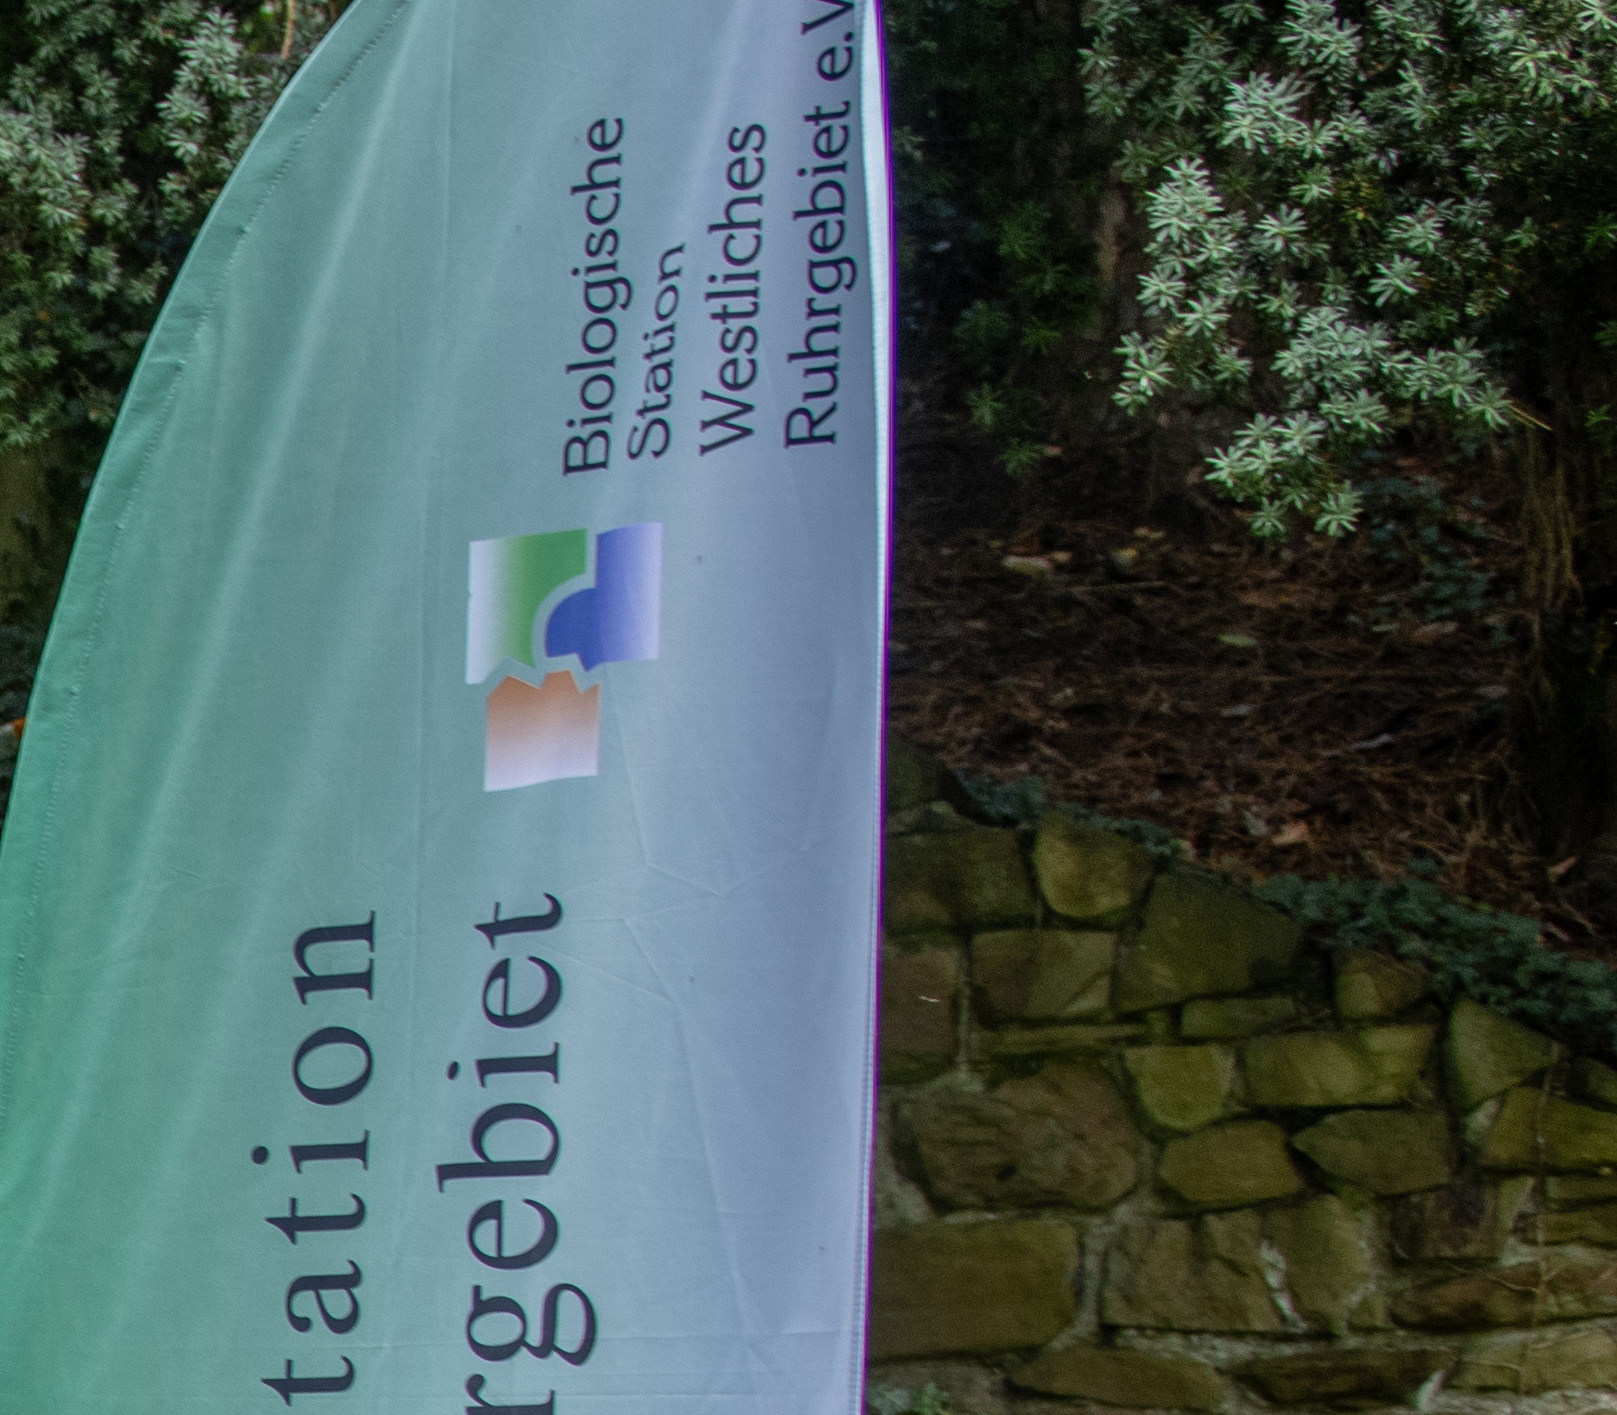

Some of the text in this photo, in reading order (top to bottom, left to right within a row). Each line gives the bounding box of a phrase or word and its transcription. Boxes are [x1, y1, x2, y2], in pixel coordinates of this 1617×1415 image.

[563, 118, 632, 476] Biologische
[628, 243, 685, 460] Station
[699, 124, 767, 456] Westliches
[784, 100, 857, 449] Ruhrgebiet
